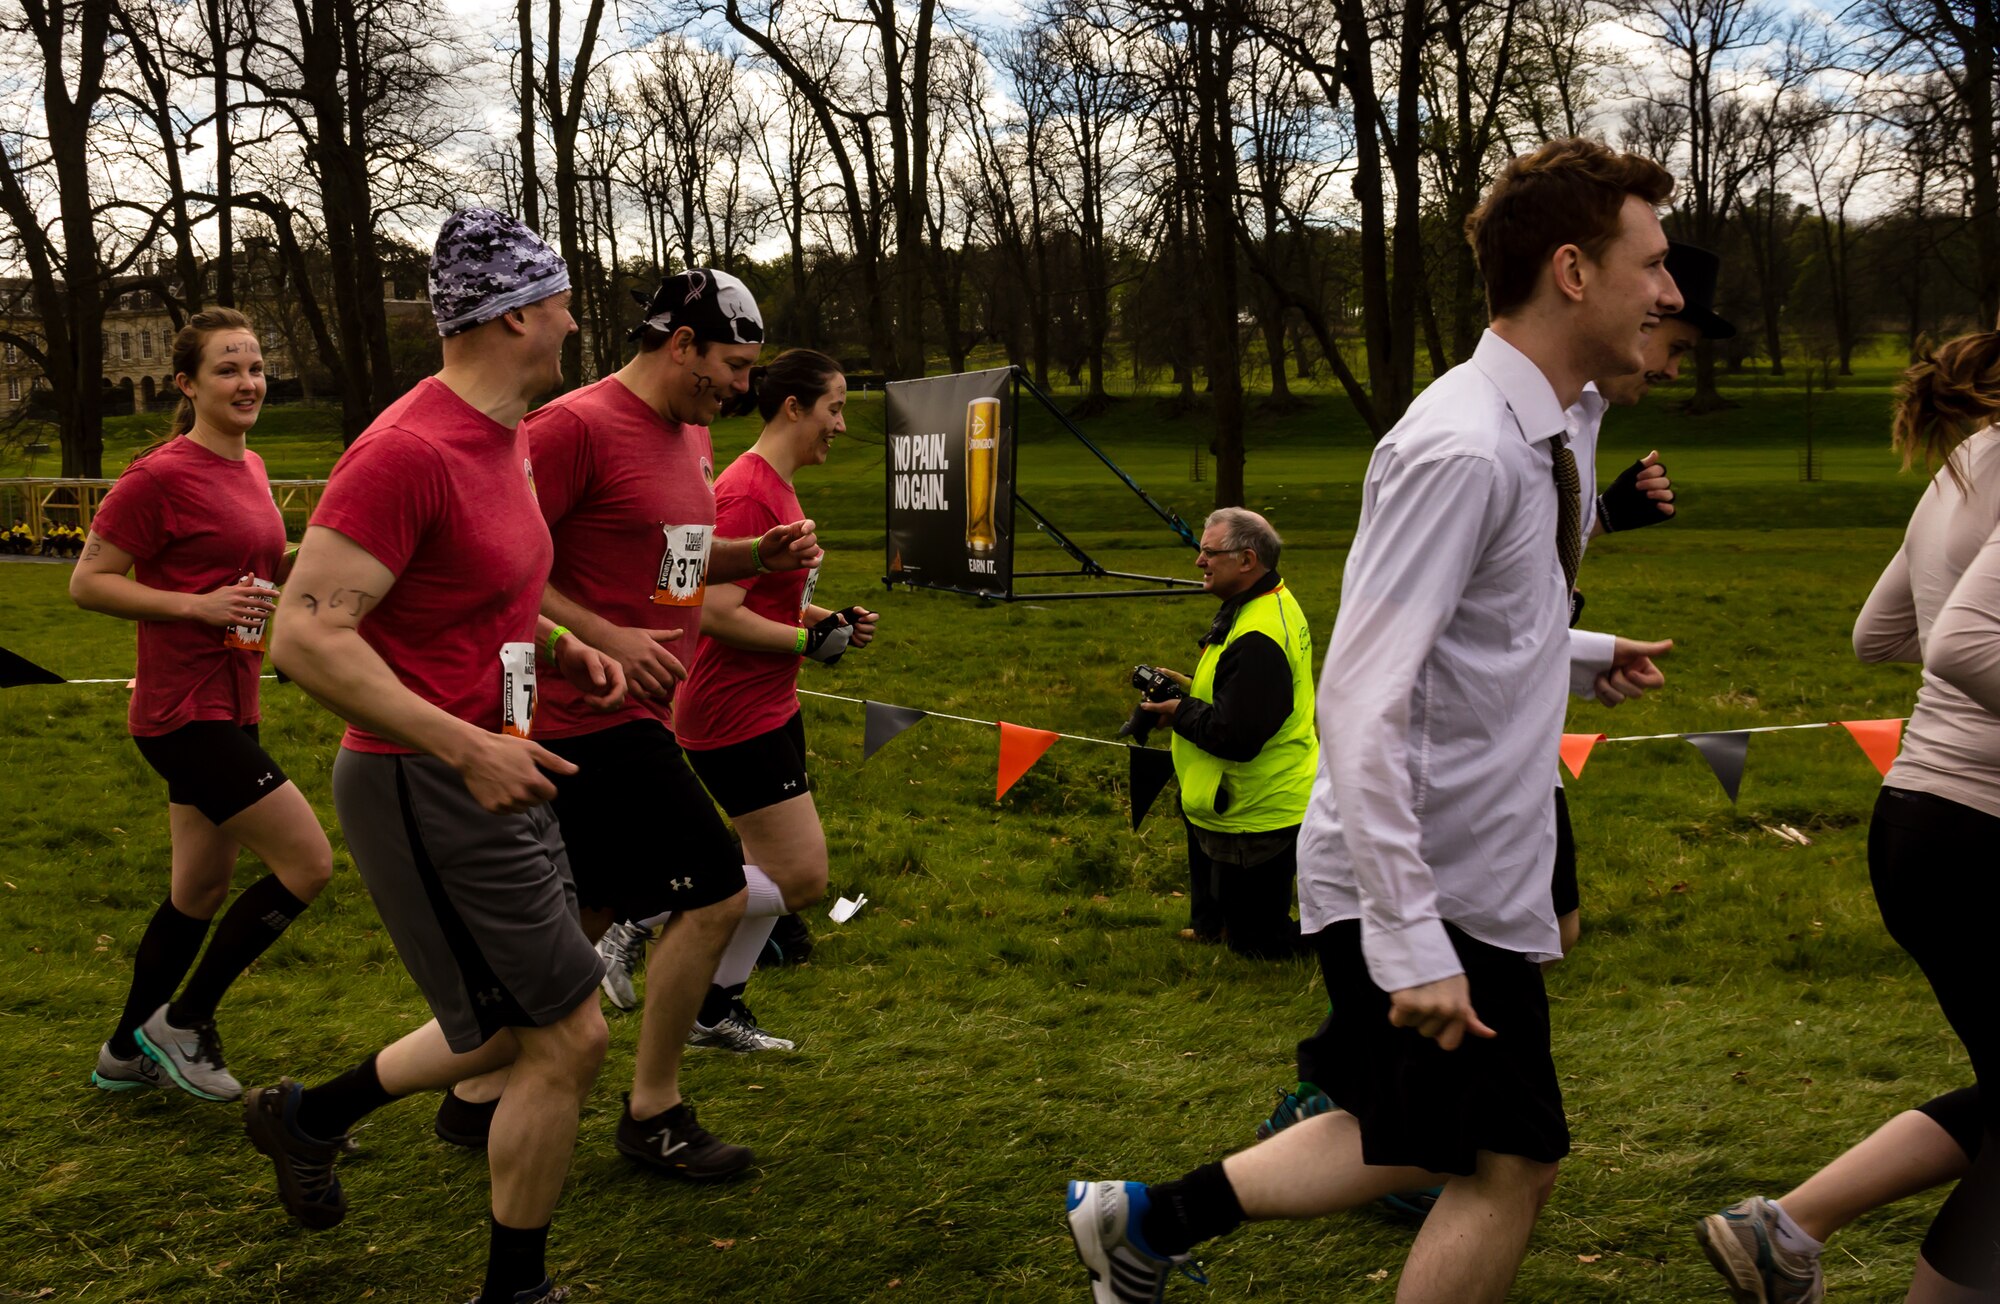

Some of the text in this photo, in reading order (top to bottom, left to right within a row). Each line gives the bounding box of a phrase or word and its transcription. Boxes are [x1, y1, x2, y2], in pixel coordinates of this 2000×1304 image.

[895, 433, 949, 471] NO PAIN.
[895, 473, 949, 511] NO GAIN.
[968, 558, 997, 575] EARN IT.
[506, 675, 514, 723] SATURDAY
